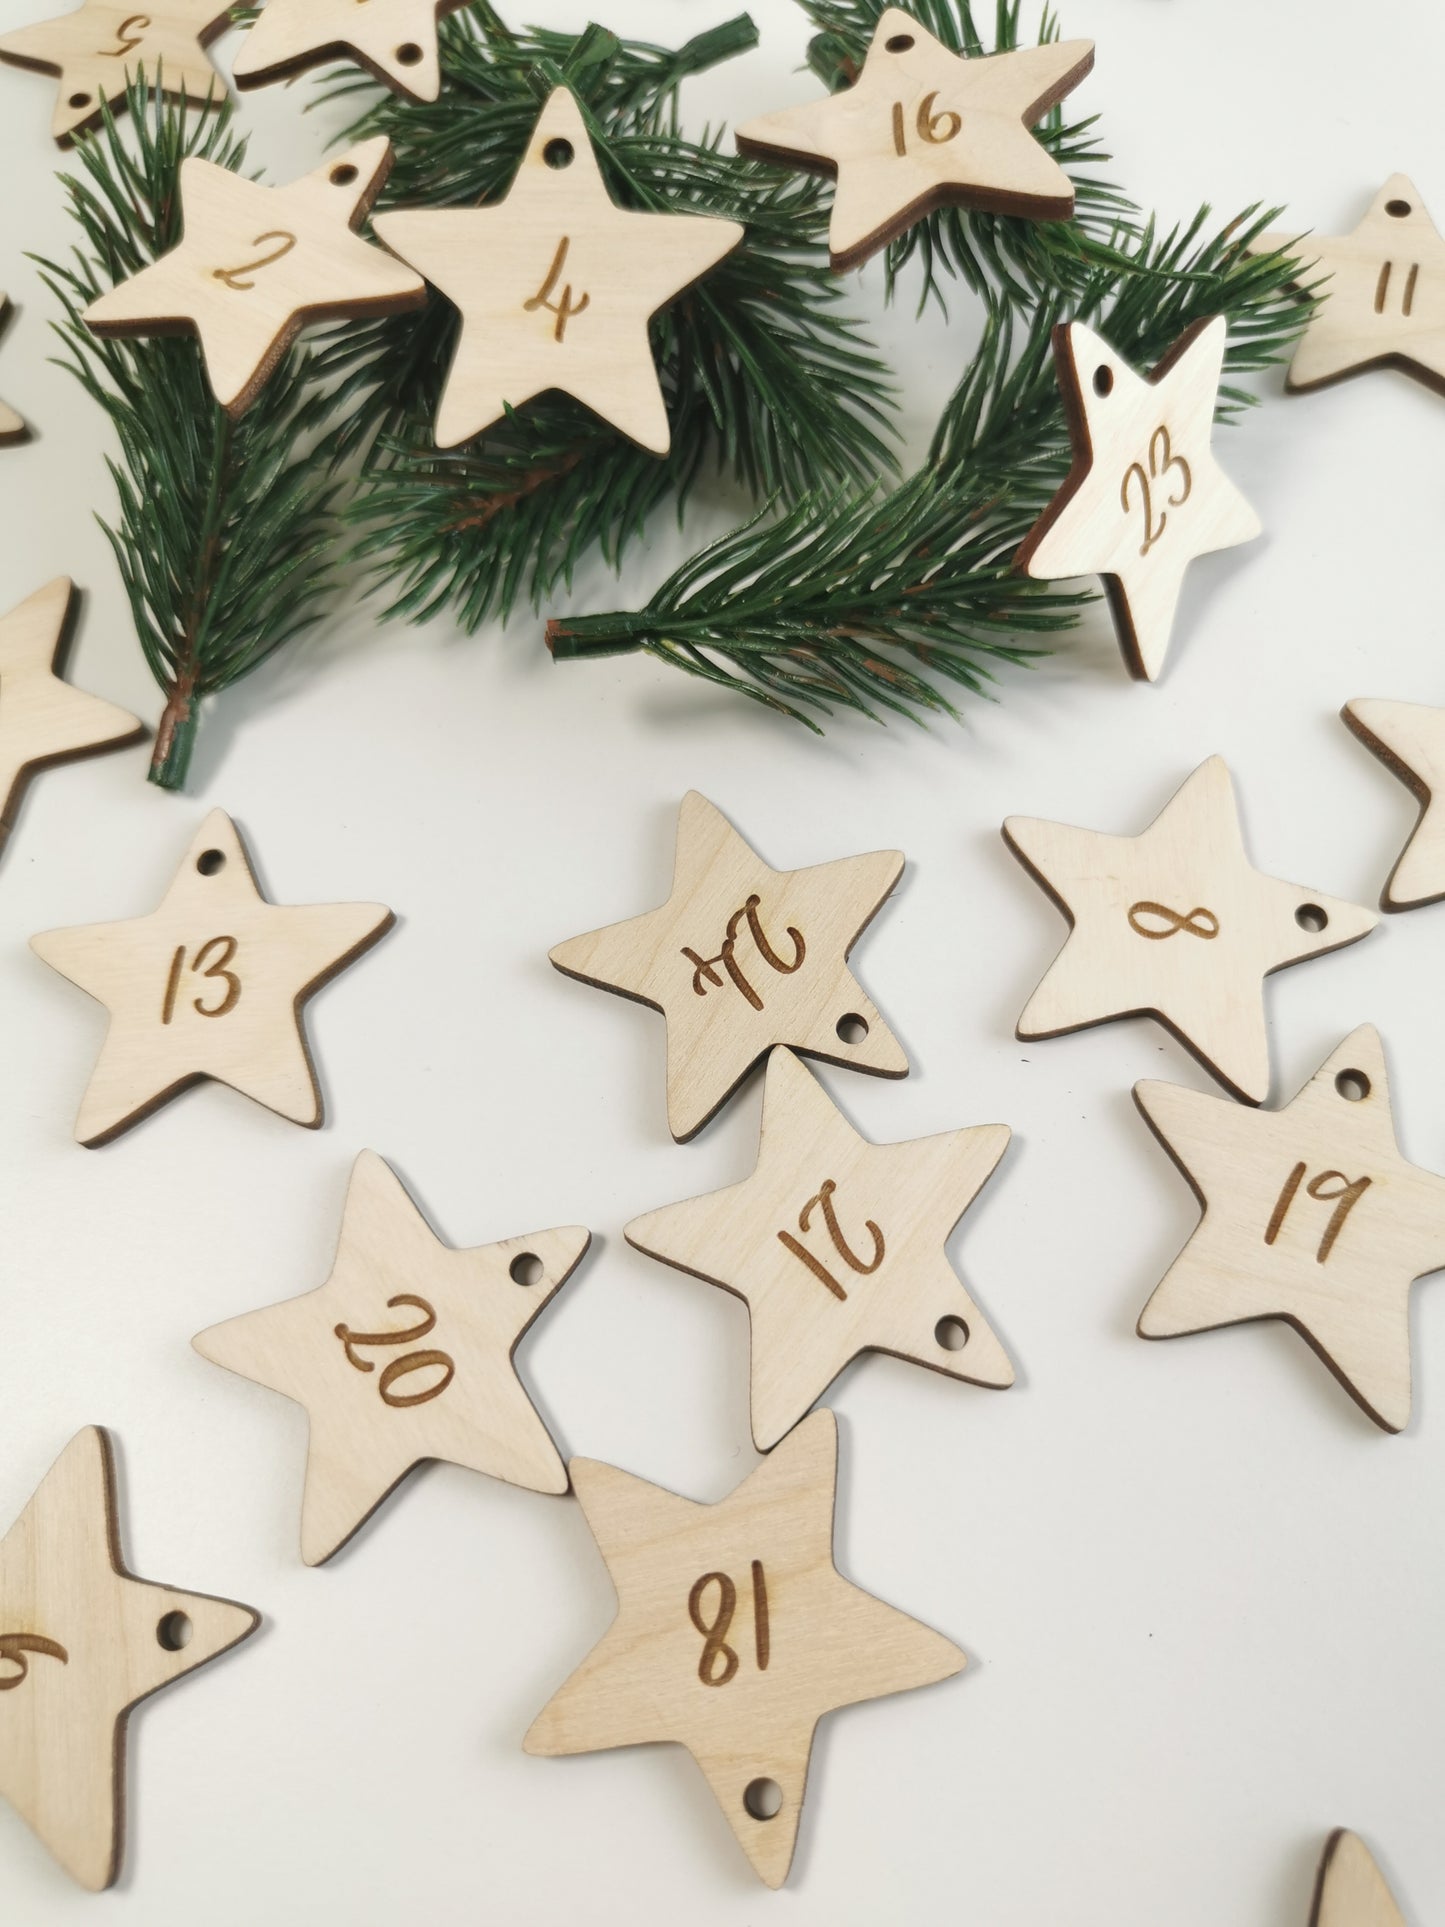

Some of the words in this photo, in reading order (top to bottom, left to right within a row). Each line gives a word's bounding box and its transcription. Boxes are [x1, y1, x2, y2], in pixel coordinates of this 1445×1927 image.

[98, 14, 151, 58] 5
[891, 91, 962, 158] 16
[212, 229, 298, 291] 2
[523, 235, 591, 343] 4
[1374, 260, 1420, 317] 11
[1120, 424, 1193, 557] 23
[680, 893, 807, 1012] 24
[1127, 900, 1220, 941] 8
[161, 935, 242, 1026] 13
[776, 1178, 886, 1303] 21
[1263, 1161, 1373, 1264] 19
[333, 1293, 456, 1409] 20
[687, 1559, 771, 1688] 18
